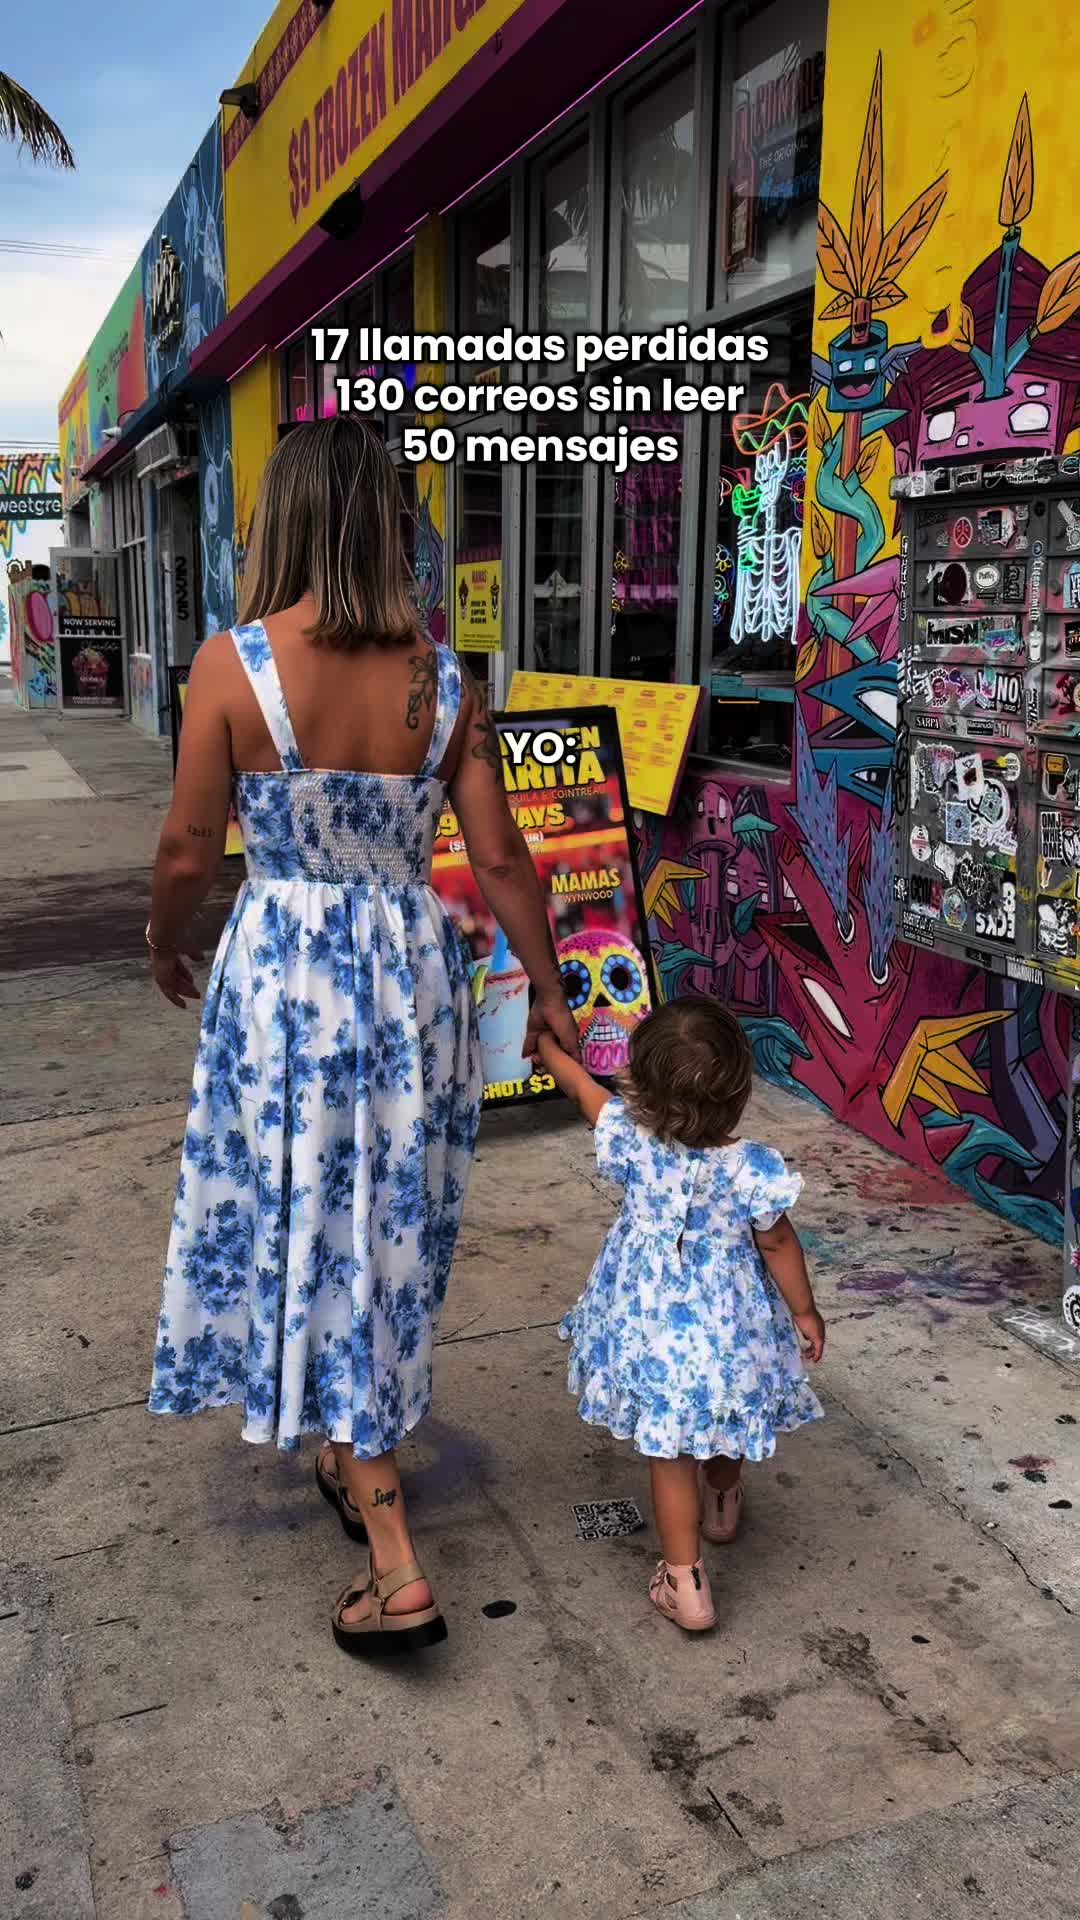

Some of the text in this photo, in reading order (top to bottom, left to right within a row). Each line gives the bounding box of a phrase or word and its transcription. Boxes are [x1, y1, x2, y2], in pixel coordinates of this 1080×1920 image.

[288, 127, 311, 225] $9
[314, 9, 388, 192] FROZEN
[63, 618, 116, 627] NOW SERVING
[551, 867, 620, 894] MAMAS
[561, 889, 613, 903] WYNWOOD
[529, 1074, 556, 1094] $3
